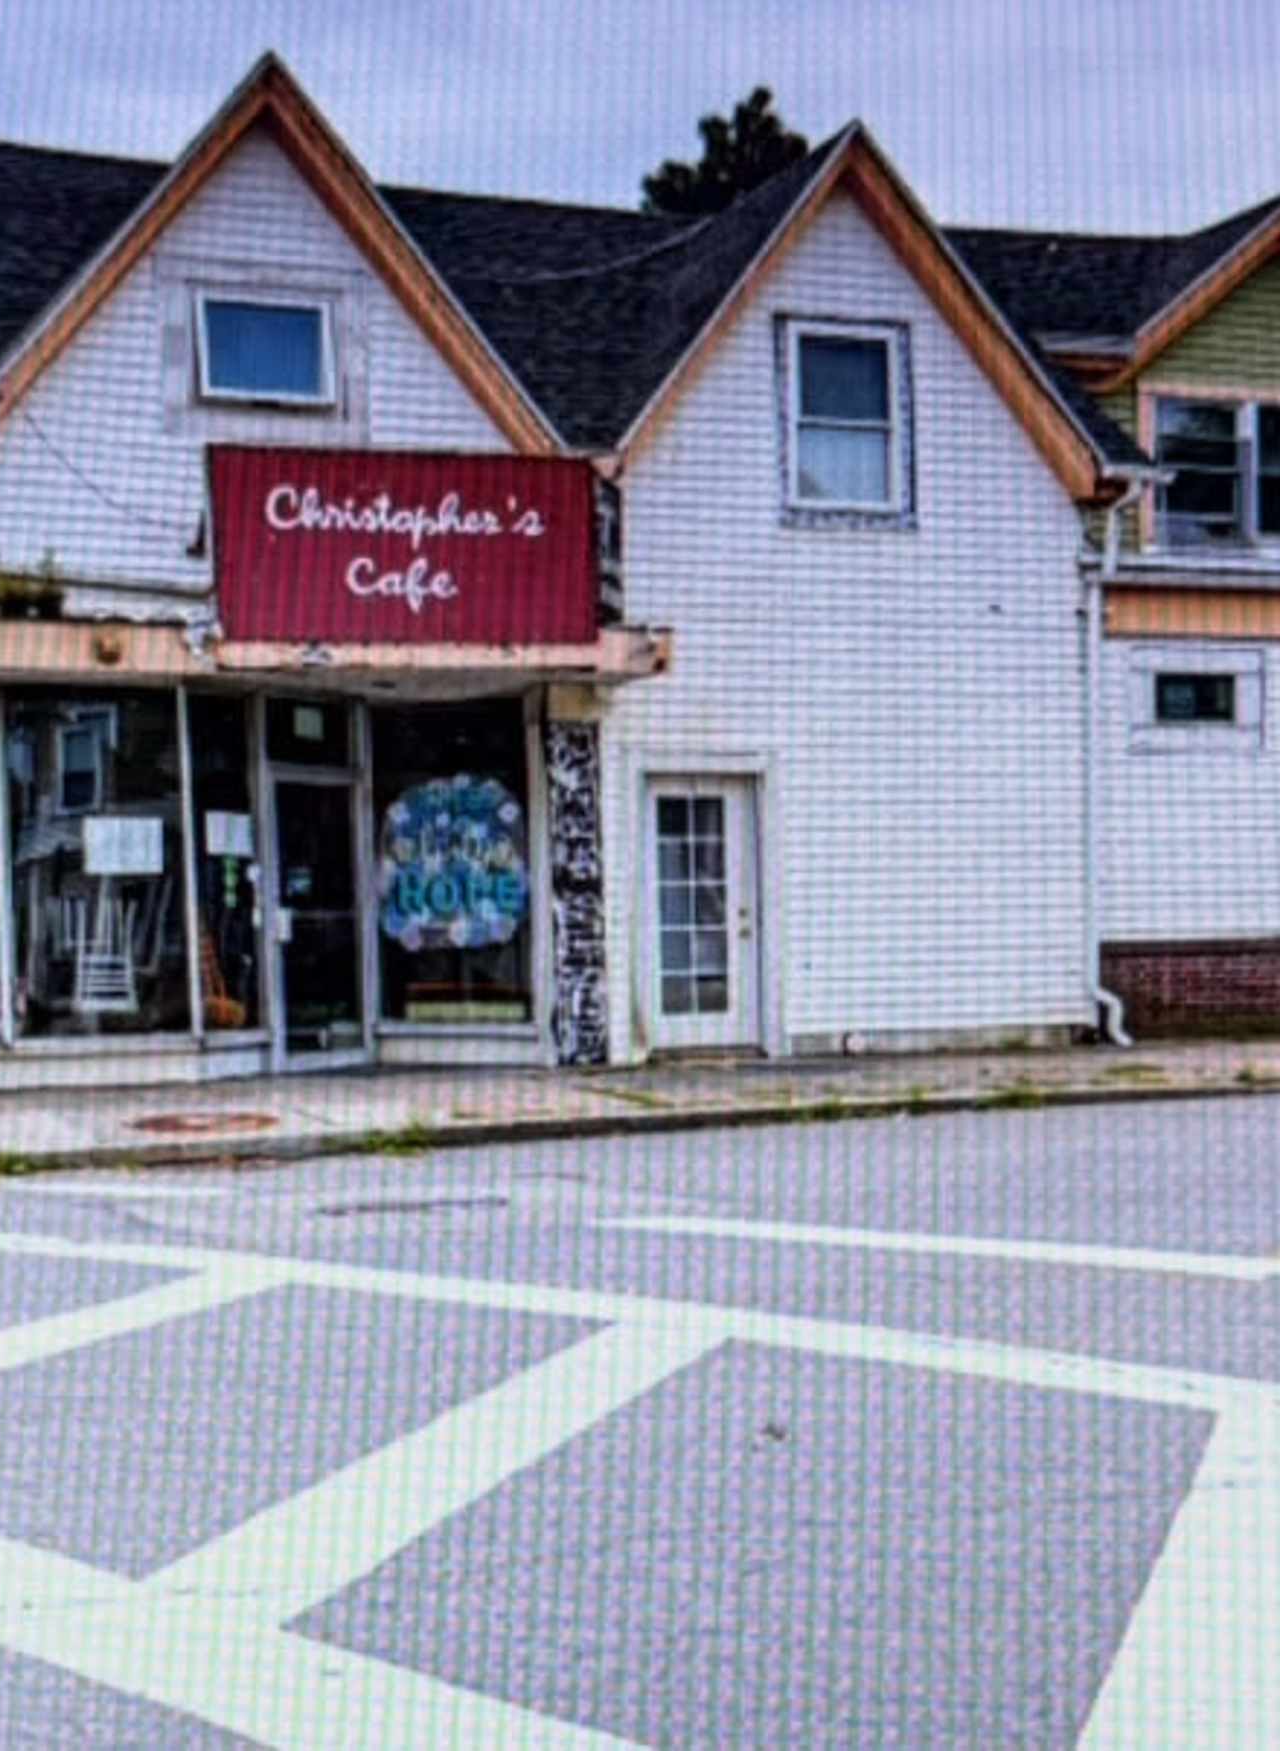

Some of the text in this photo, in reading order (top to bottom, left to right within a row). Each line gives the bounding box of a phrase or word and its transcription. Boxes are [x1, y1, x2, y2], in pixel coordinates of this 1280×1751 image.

[265, 487, 544, 550] Christopher's
[345, 558, 459, 613] Cafe
[397, 872, 521, 914] HOPE
